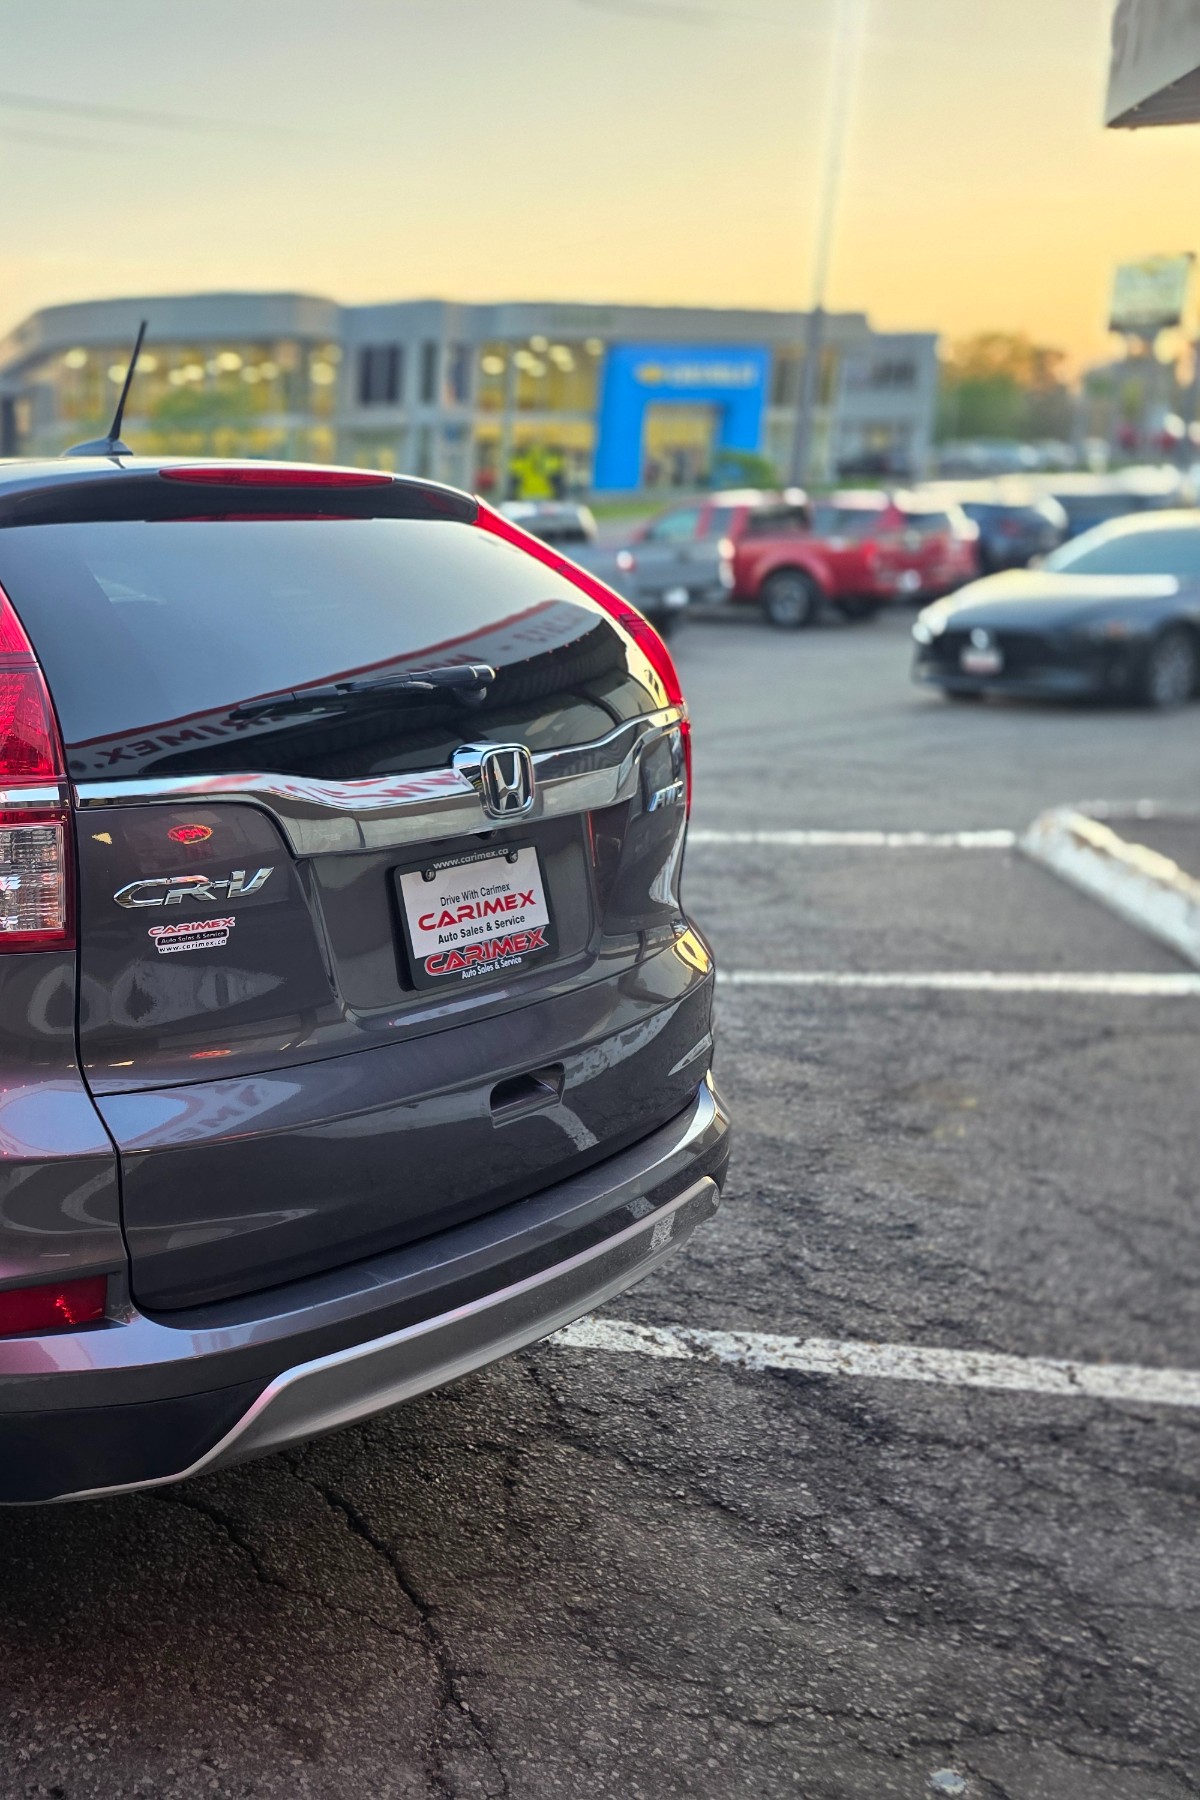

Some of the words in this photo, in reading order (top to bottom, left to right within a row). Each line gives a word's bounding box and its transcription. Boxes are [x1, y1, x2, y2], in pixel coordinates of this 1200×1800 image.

[432, 848, 509, 869] www.carimex.ca
[113, 866, 275, 909] CR-V
[440, 895, 461, 907] Drive
[461, 890, 480, 902] With
[480, 883, 511, 897] Carimex
[418, 889, 537, 931] CARIMEX
[149, 917, 235, 936] CARIMEX
[438, 933, 459, 945] Auto
[461, 926, 484, 938] Sales
[486, 922, 493, 932] &
[495, 915, 526, 929] Service
[159, 939, 226, 953] www.carimex.ca
[425, 926, 548, 976] CARIMEX
[461, 969, 478, 980] Auto
[478, 963, 494, 975] Sales
[495, 961, 501, 970] &
[501, 956, 522, 968] Service
